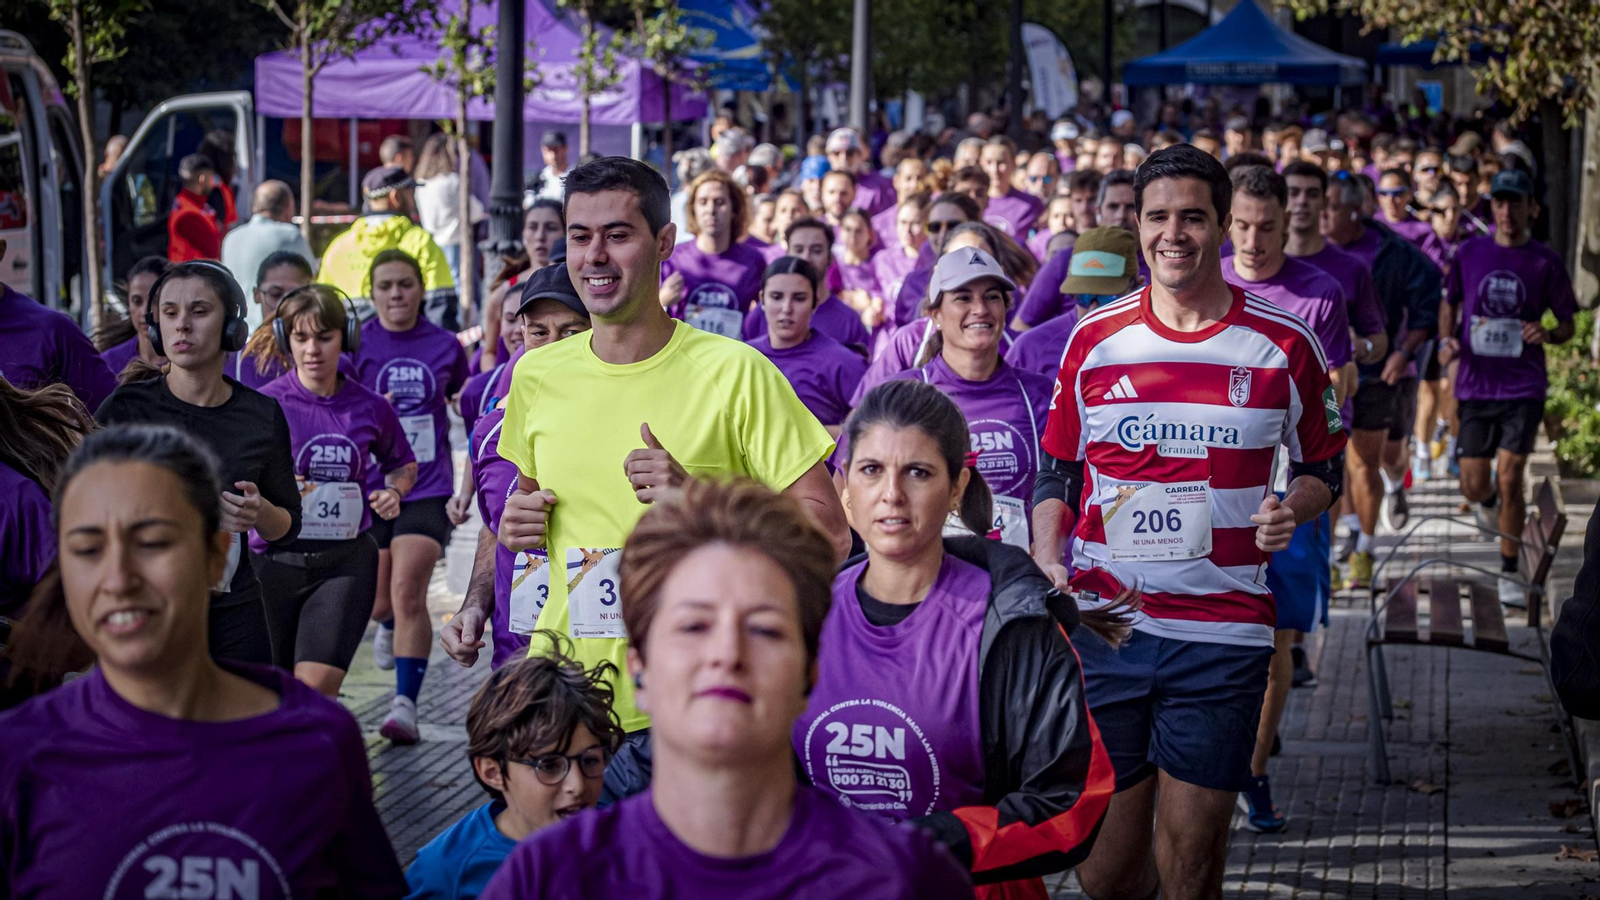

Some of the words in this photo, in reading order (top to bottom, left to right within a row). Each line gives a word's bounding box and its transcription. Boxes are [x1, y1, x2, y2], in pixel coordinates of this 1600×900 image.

[388, 366, 424, 382] 25N
[970, 430, 1014, 453] 25N
[1158, 444, 1206, 456] Granada
[310, 444, 352, 463] 25N
[318, 501, 341, 519] 34
[1132, 508, 1182, 534] 206
[599, 578, 617, 606] 3
[805, 710, 830, 760] INTERNACIONAL
[830, 699, 860, 712] CONTRA
[872, 699, 906, 719] VIOLENCIA
[905, 716, 924, 739] HACIA
[921, 738, 933, 753] LAS
[929, 753, 940, 786] MUJERES
[824, 721, 906, 760] 25N
[833, 774, 860, 785] 900
[861, 774, 875, 785] 21
[876, 776, 888, 787] 21
[888, 778, 906, 789] 30
[142, 855, 260, 900] 25N
